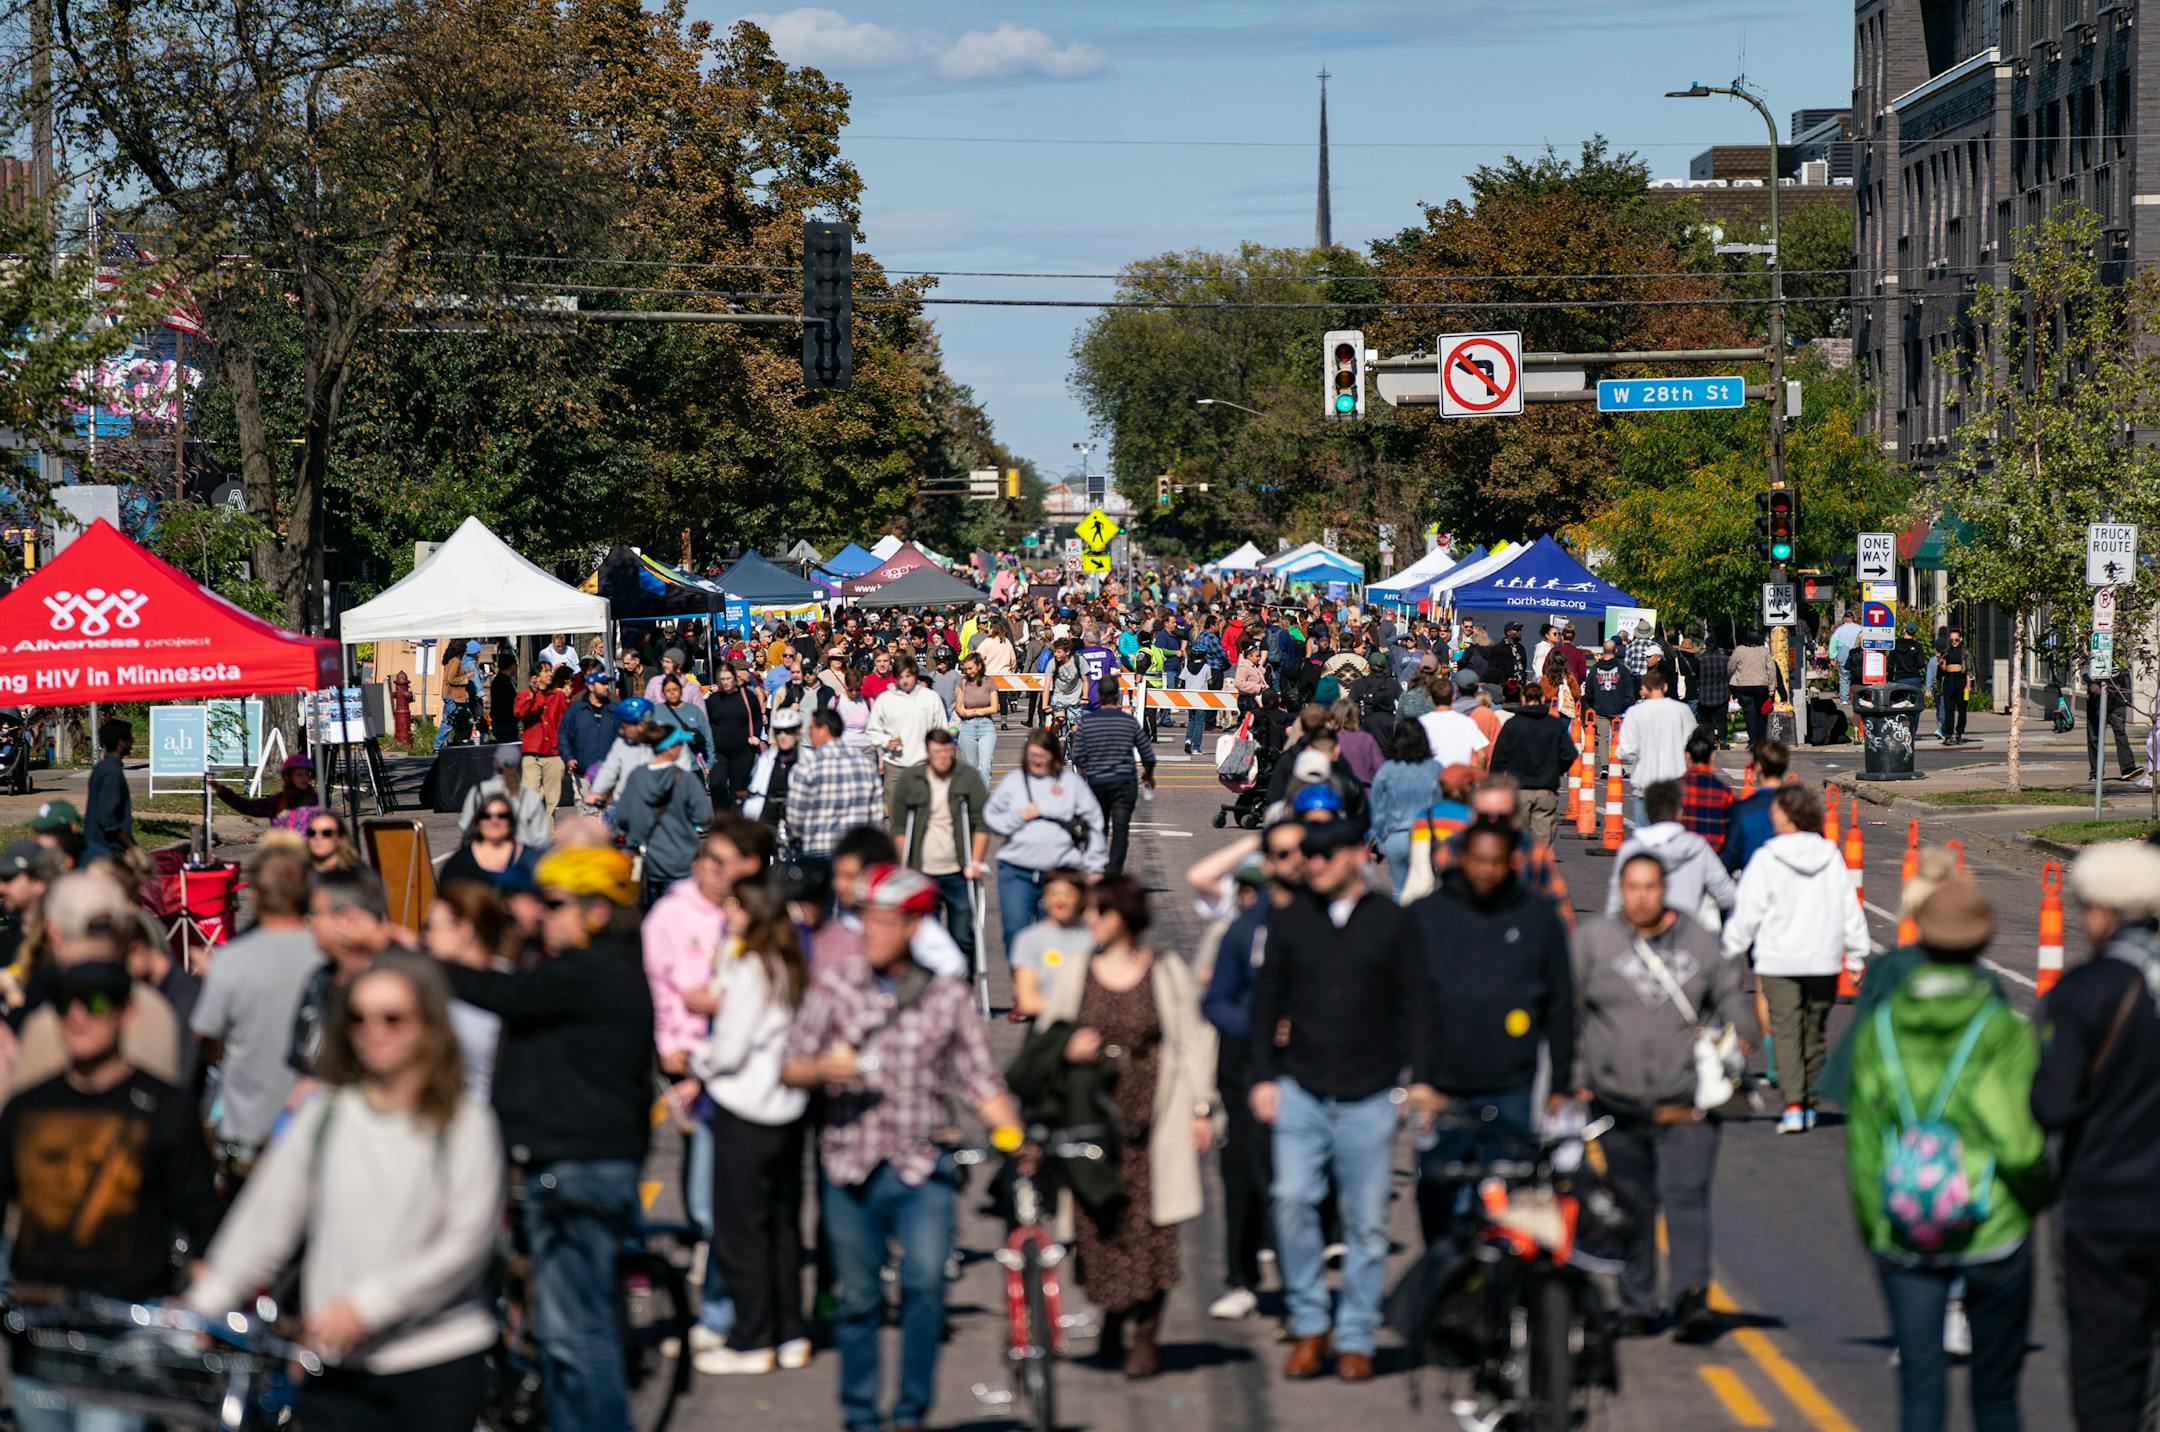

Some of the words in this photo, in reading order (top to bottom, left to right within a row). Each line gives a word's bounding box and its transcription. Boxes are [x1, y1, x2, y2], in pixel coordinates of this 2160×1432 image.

[1613, 387, 1630, 404] W
[1642, 386, 1693, 402] 28th
[1706, 384, 1729, 401] St
[2094, 528, 2132, 541] TRUCK
[1863, 537, 1891, 549] ONE
[2093, 541, 2132, 553] ROUTE
[1862, 551, 1891, 563] WAY
[1768, 586, 1792, 598] ONE
[1507, 596, 1587, 611] north-stars.org
[1767, 598, 1792, 609] WAY
[12, 638, 140, 653] Aliveness
[144, 635, 212, 649] project
[35, 667, 80, 689] HIV
[87, 666, 109, 687] in
[116, 661, 242, 685] Minnesota
[1090, 660, 1103, 681] 5
